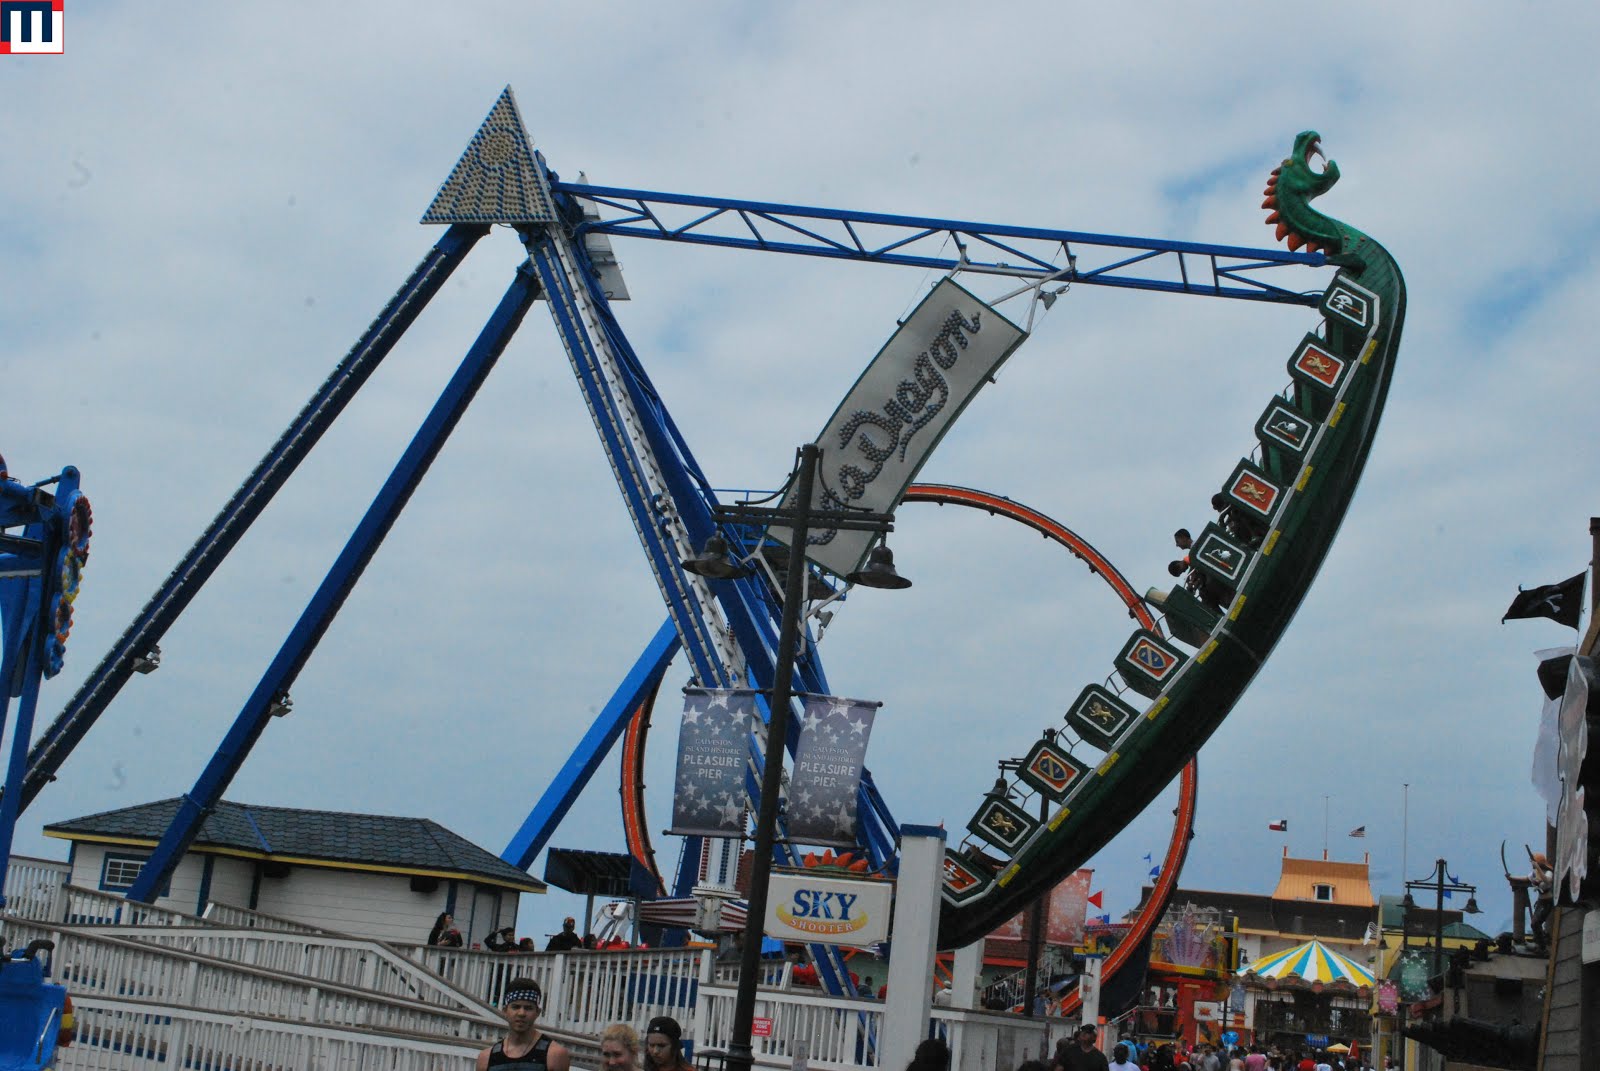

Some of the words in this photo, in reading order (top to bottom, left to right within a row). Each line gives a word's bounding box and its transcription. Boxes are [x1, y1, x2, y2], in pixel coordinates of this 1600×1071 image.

[839, 308, 981, 463] Dragon
[683, 754, 741, 768] PLEASURE
[698, 768, 722, 779] PIER
[800, 761, 856, 777] PLEASURE
[813, 776, 836, 788] PIER
[792, 889, 858, 920] SKY
[791, 919, 854, 932] SHOOTER
